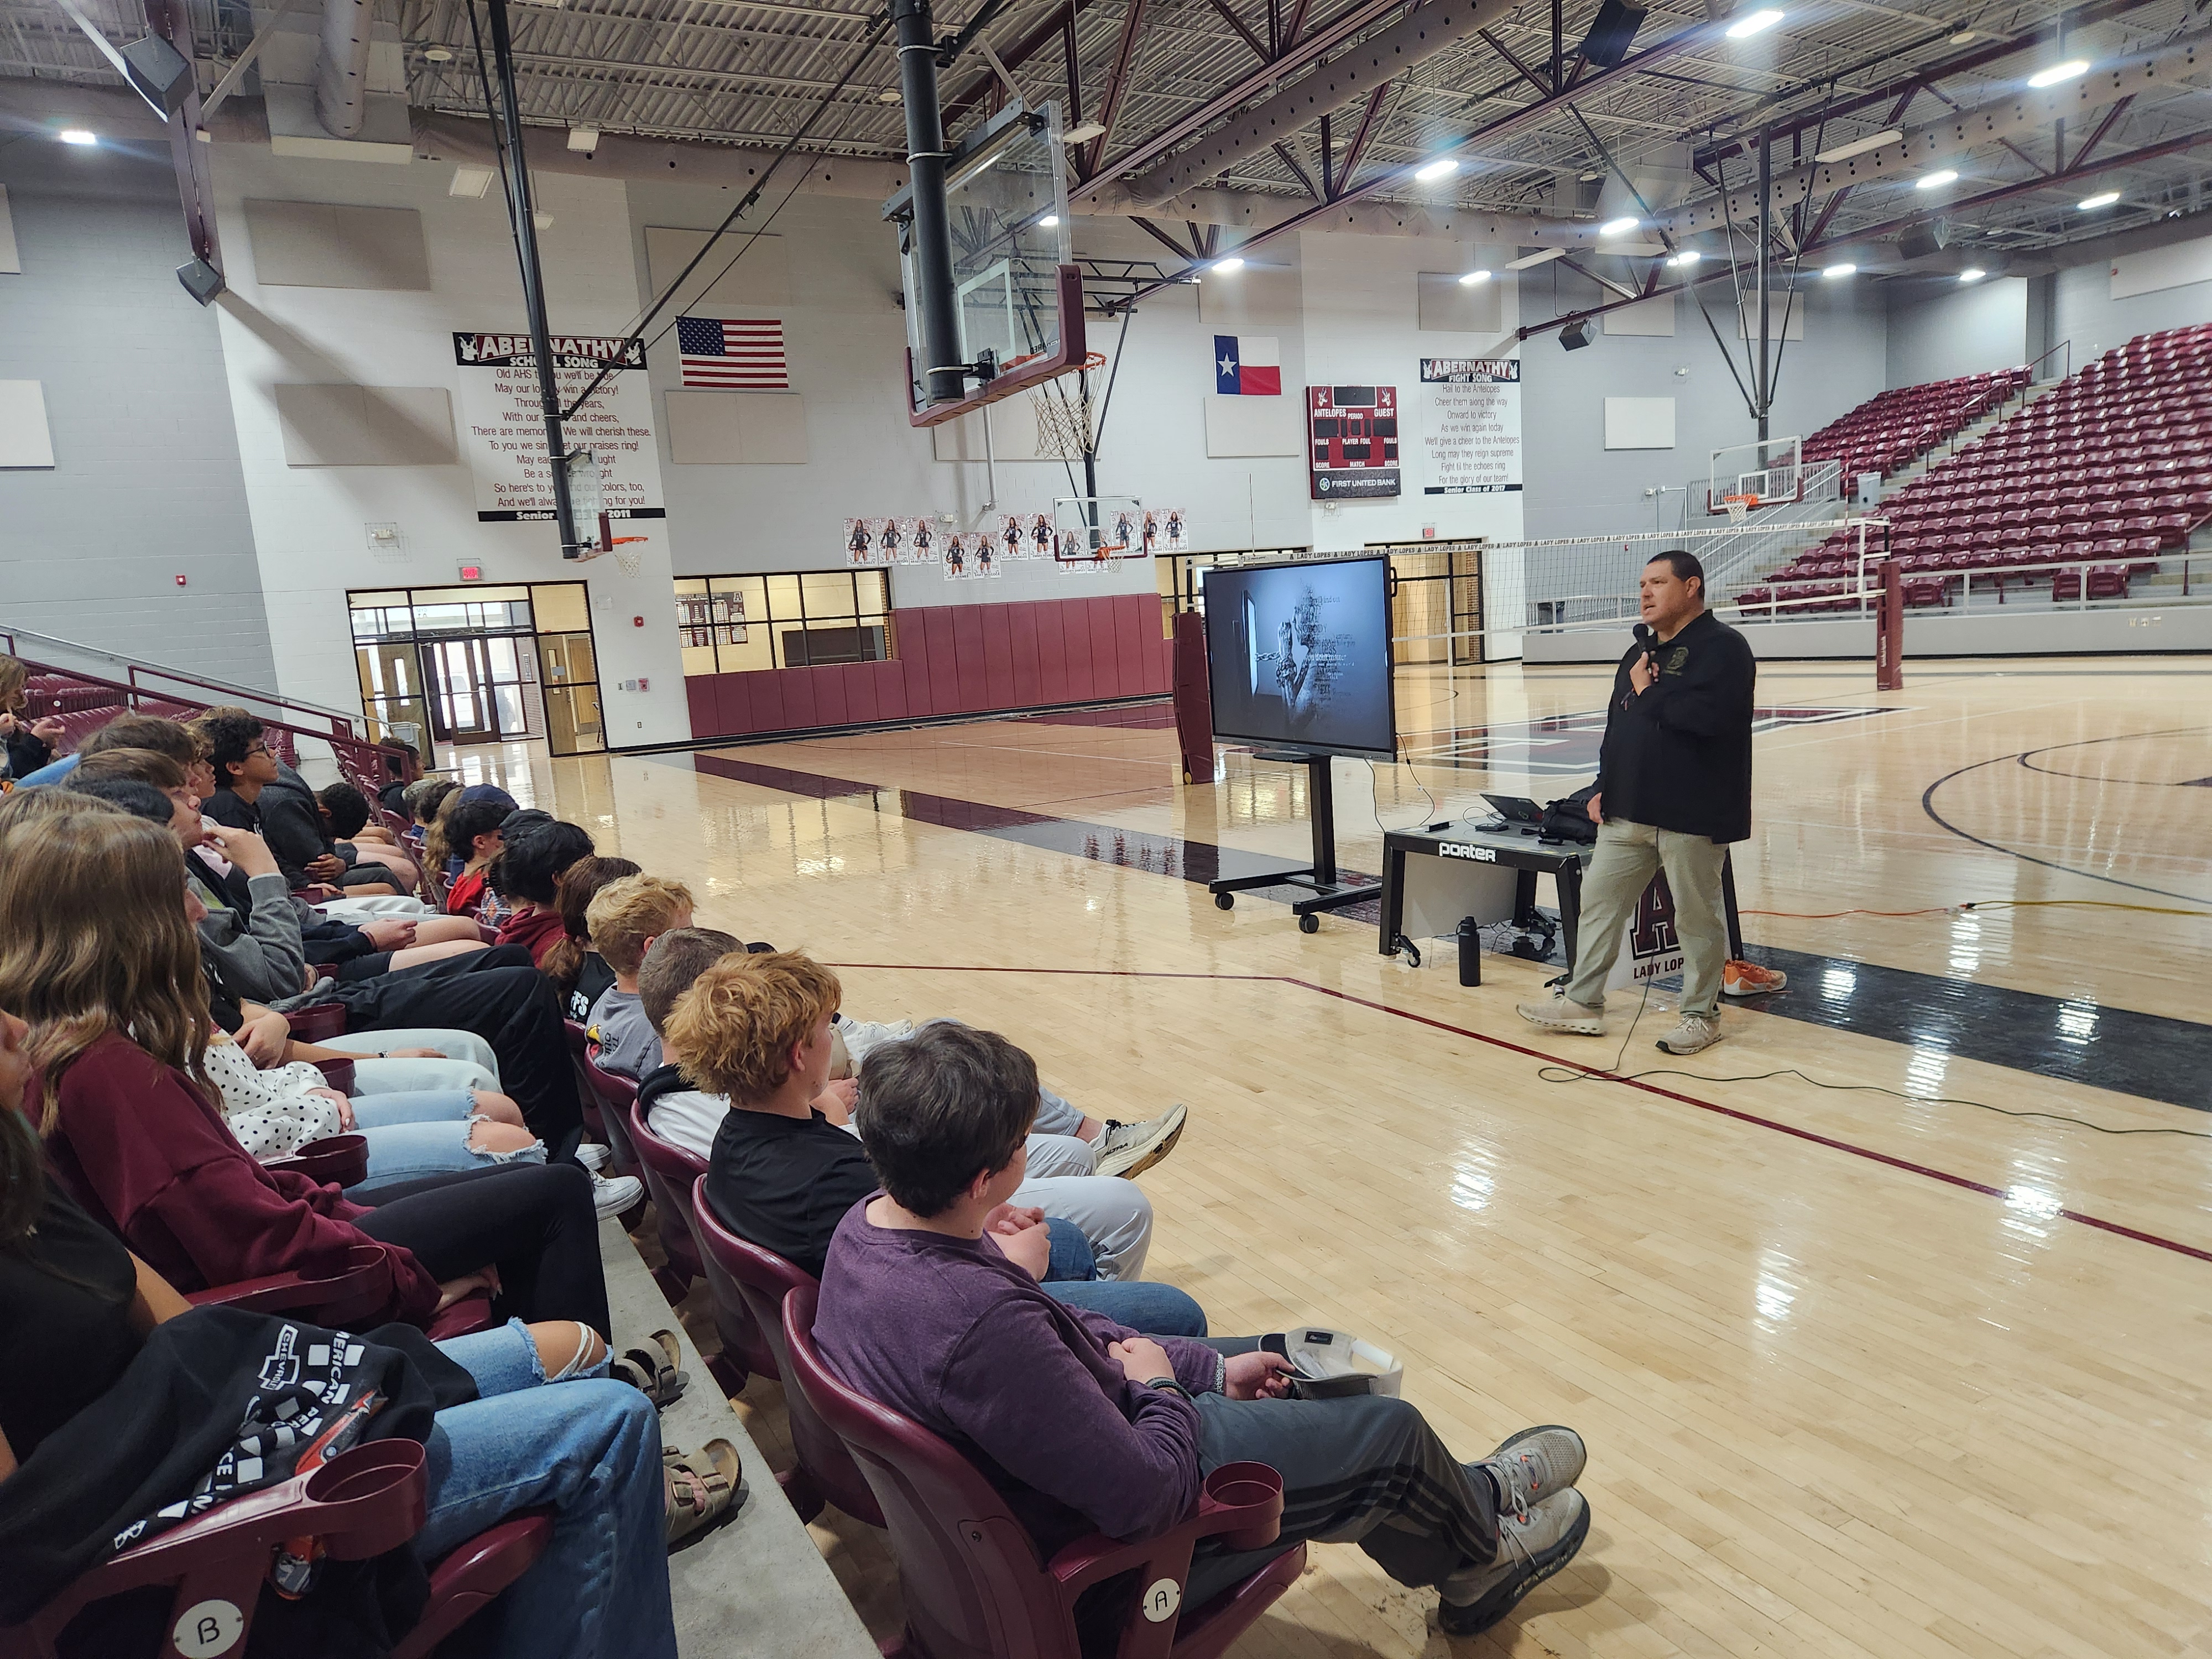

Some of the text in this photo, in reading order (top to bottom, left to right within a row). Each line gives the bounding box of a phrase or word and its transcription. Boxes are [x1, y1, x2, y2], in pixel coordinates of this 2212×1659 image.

[510, 356, 599, 368] SCHL SONG
[496, 368, 510, 379] Old
[514, 369, 532, 379] AHS
[564, 371, 581, 379] we'll
[584, 371, 595, 380] be
[1432, 361, 1509, 378] ABERNATHY
[1448, 373, 1493, 383] FIGHT SONG
[494, 383, 513, 395] May
[563, 384, 578, 394] win
[1442, 384, 1500, 395] Hail to the Antelopes
[514, 398, 604, 410] Throug the years,
[1434, 397, 1508, 408] Cheer them along the way
[502, 412, 523, 421] With
[572, 414, 587, 422] and
[589, 413, 619, 422] cheers,
[1314, 408, 1347, 418] ANTELOPES
[1374, 408, 1394, 418] GUEST
[1447, 410, 1497, 420] Onward to victory
[471, 426, 497, 436] There
[563, 426, 577, 436] We
[579, 427, 593, 436] will
[595, 427, 625, 436] cherish
[627, 427, 651, 436] these.
[1441, 424, 1449, 432] As
[1460, 423, 1471, 432] win
[1472, 423, 1487, 434] again
[1488, 422, 1504, 433] today
[488, 440, 499, 450] To
[502, 442, 518, 452] you
[621, 441, 639, 452] ring!
[1425, 436, 1438, 446] We'll
[1439, 436, 1452, 447] give
[1458, 436, 1474, 445] cheer
[1475, 436, 1481, 445] to
[1482, 436, 1491, 445] the
[1493, 435, 1520, 446] Antelopes
[516, 455, 534, 466] May
[1431, 449, 1514, 460] Long may they reign supreme
[1441, 462, 1455, 473] Fight
[1463, 462, 1472, 471] the
[1474, 461, 1493, 470] echoes
[1495, 461, 1506, 471] ring
[524, 469, 535, 478] Be
[1438, 476, 1448, 484] For
[1449, 475, 1458, 484] the
[1460, 474, 1474, 485] glory
[1476, 474, 1482, 483] of
[1494, 473, 1509, 482] team!
[494, 483, 506, 493] So
[508, 483, 534, 493] here's
[536, 483, 545, 493] to
[629, 482, 645, 492] too,
[498, 497, 515, 507] And
[517, 497, 536, 507] we'll
[614, 496, 625, 505] for
[628, 495, 645, 507] you!
[515, 511, 555, 520] Senior
[607, 509, 632, 519] 2011
[1634, 957, 1684, 979] LADY LOP
[1101, 1142, 1128, 1159] ALTRA
[1155, 1590, 1168, 1612] A
[197, 1616, 220, 1645] B
